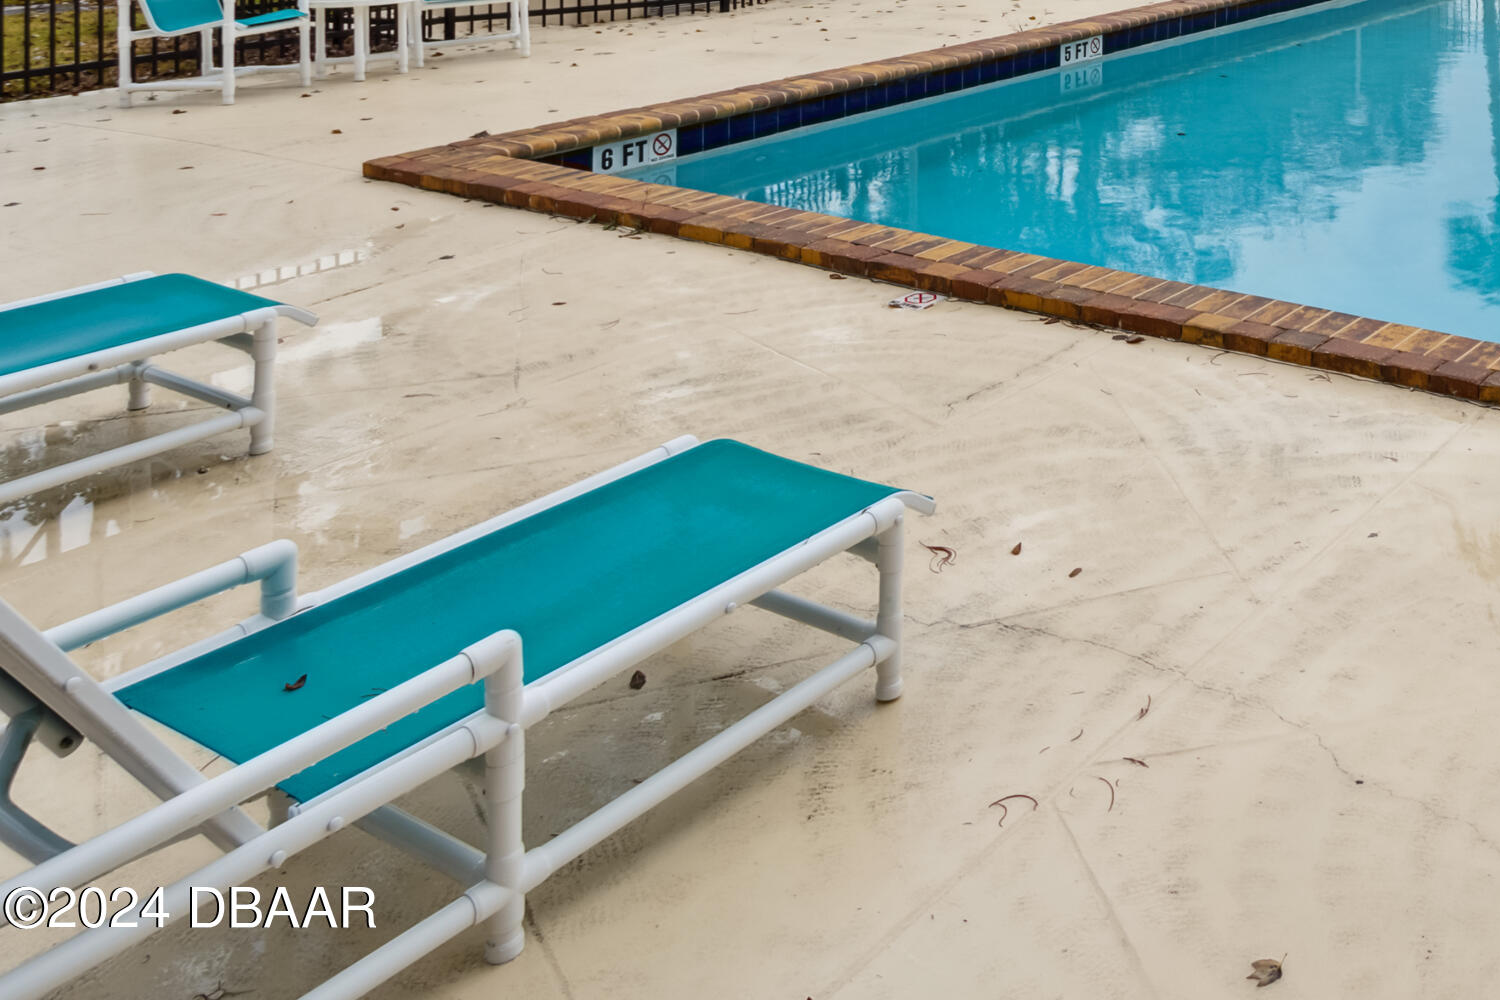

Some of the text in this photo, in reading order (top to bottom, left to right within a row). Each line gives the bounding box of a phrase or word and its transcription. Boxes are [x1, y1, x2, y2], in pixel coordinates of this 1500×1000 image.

[1064, 41, 1088, 62] 5 FT
[601, 139, 648, 171] 6 FT
